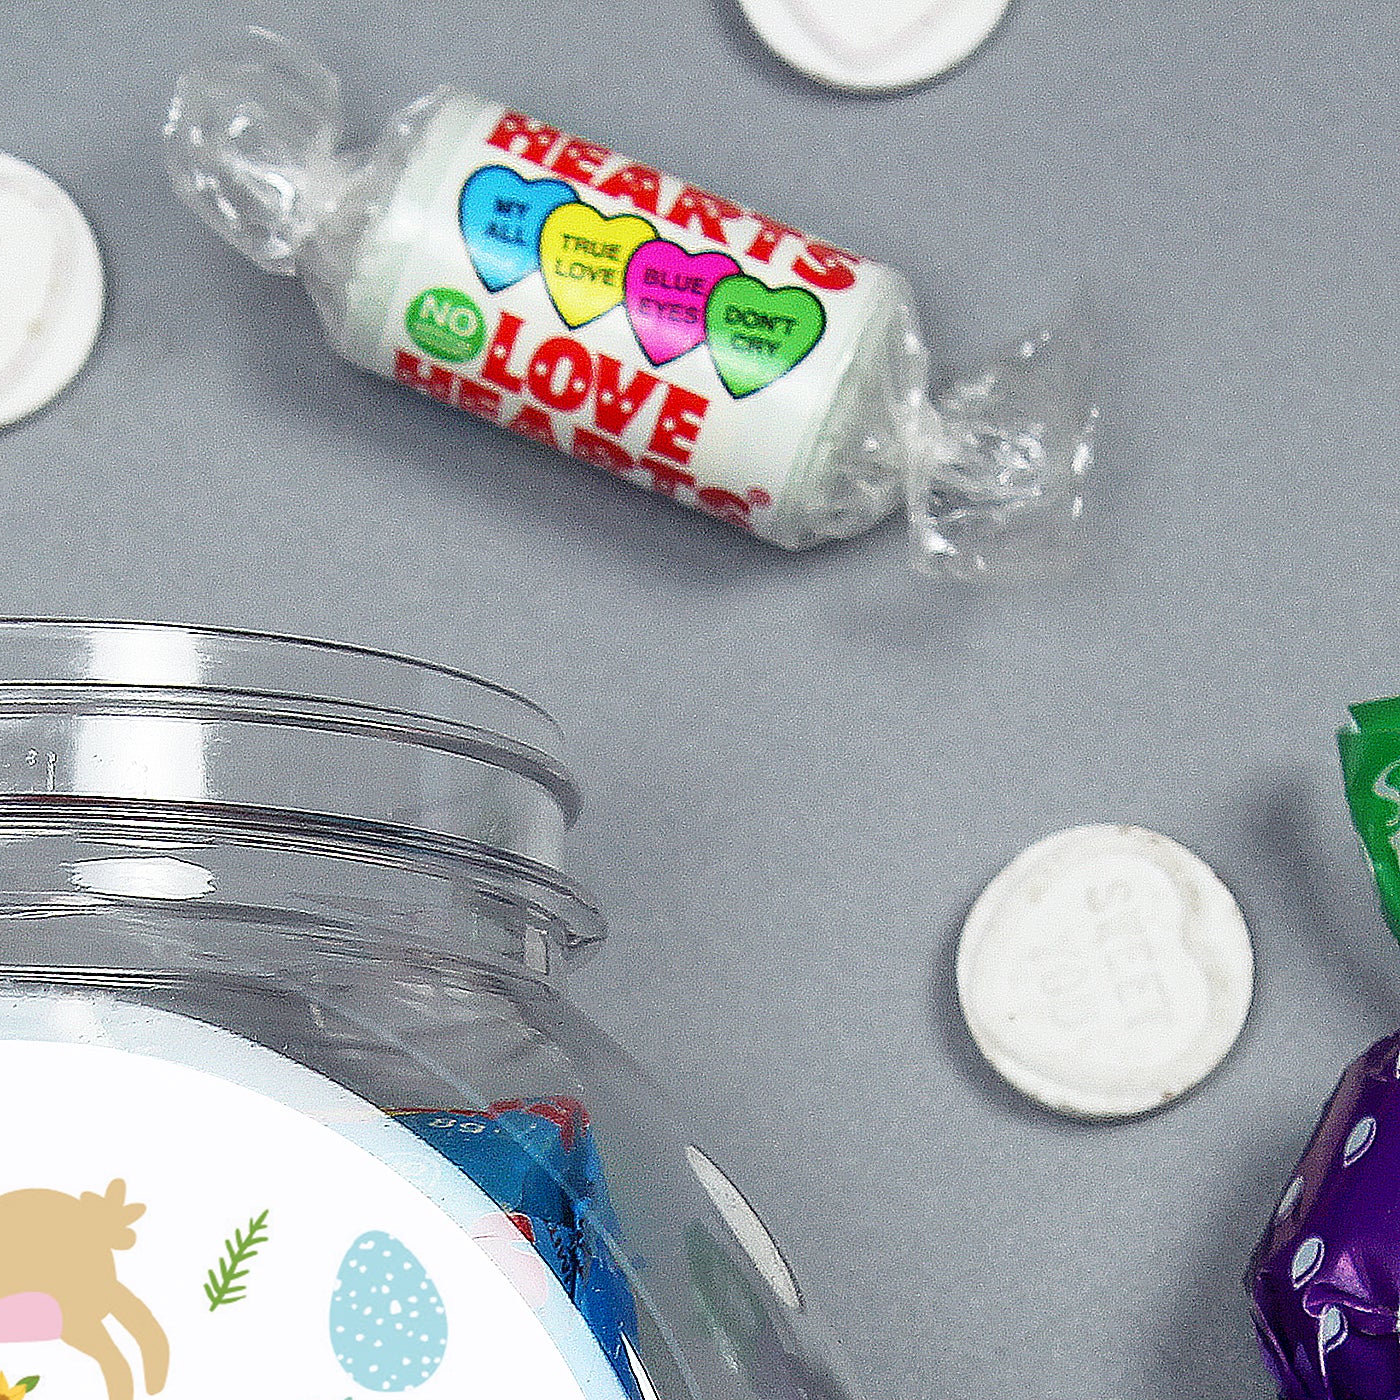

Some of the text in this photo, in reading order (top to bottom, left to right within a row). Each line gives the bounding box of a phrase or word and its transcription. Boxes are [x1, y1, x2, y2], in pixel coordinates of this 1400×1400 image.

[486, 107, 863, 292] HEARTS
[561, 232, 622, 262] TRUE
[555, 257, 615, 286] LOVE
[643, 267, 707, 296] BLUE
[418, 295, 477, 337] NO
[639, 297, 699, 325] EYES
[481, 310, 711, 464] LOVE
